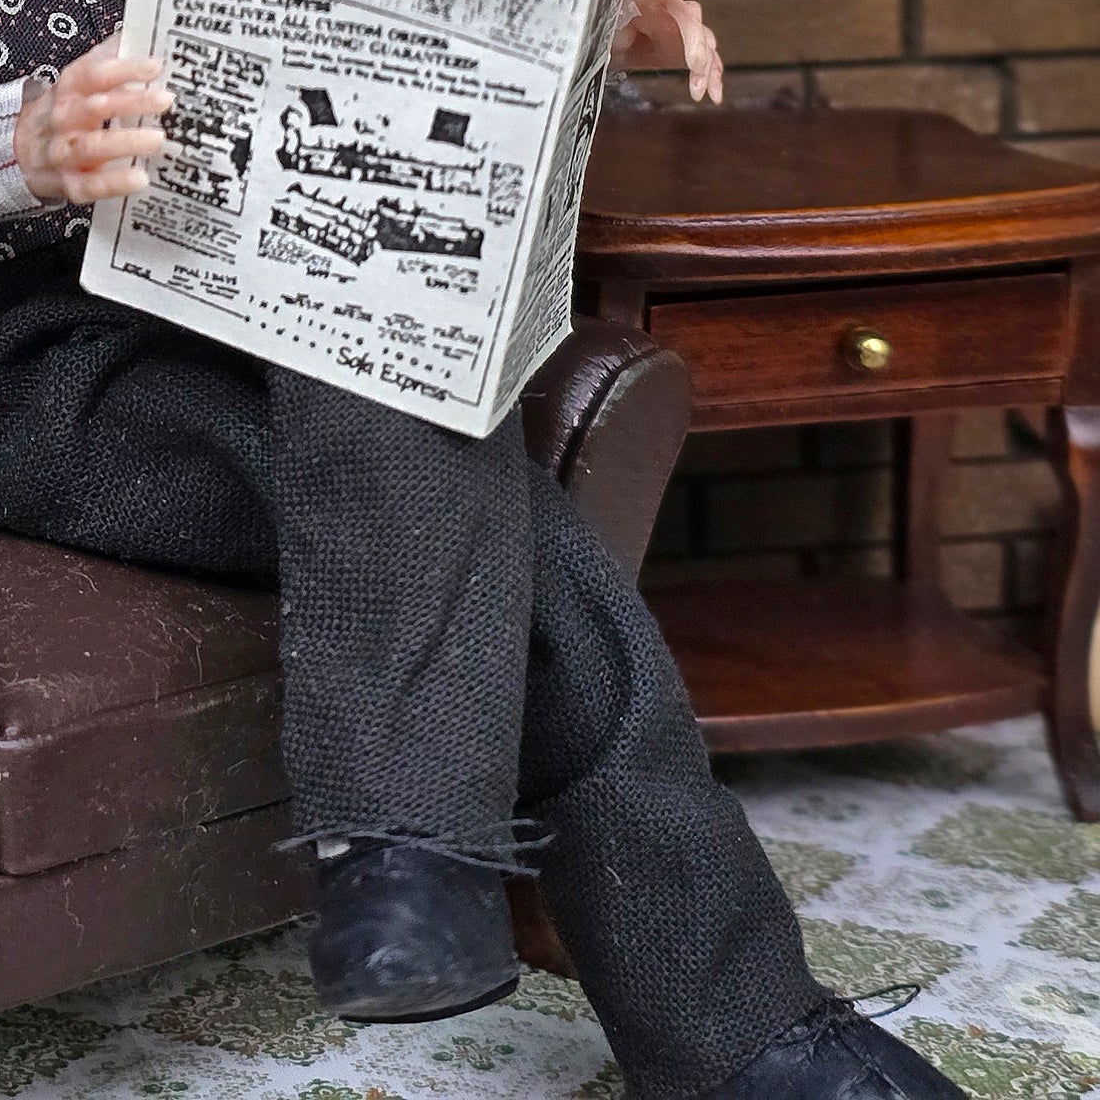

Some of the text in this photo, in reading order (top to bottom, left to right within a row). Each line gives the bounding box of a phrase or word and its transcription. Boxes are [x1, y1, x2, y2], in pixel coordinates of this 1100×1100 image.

[173, 12, 232, 34] BEFORE
[208, 0, 276, 23] DELIVER
[281, 13, 310, 29] ALL
[315, 17, 382, 39] CUSTOM
[336, 346, 374, 376] Sofa
[380, 363, 448, 402] Express
